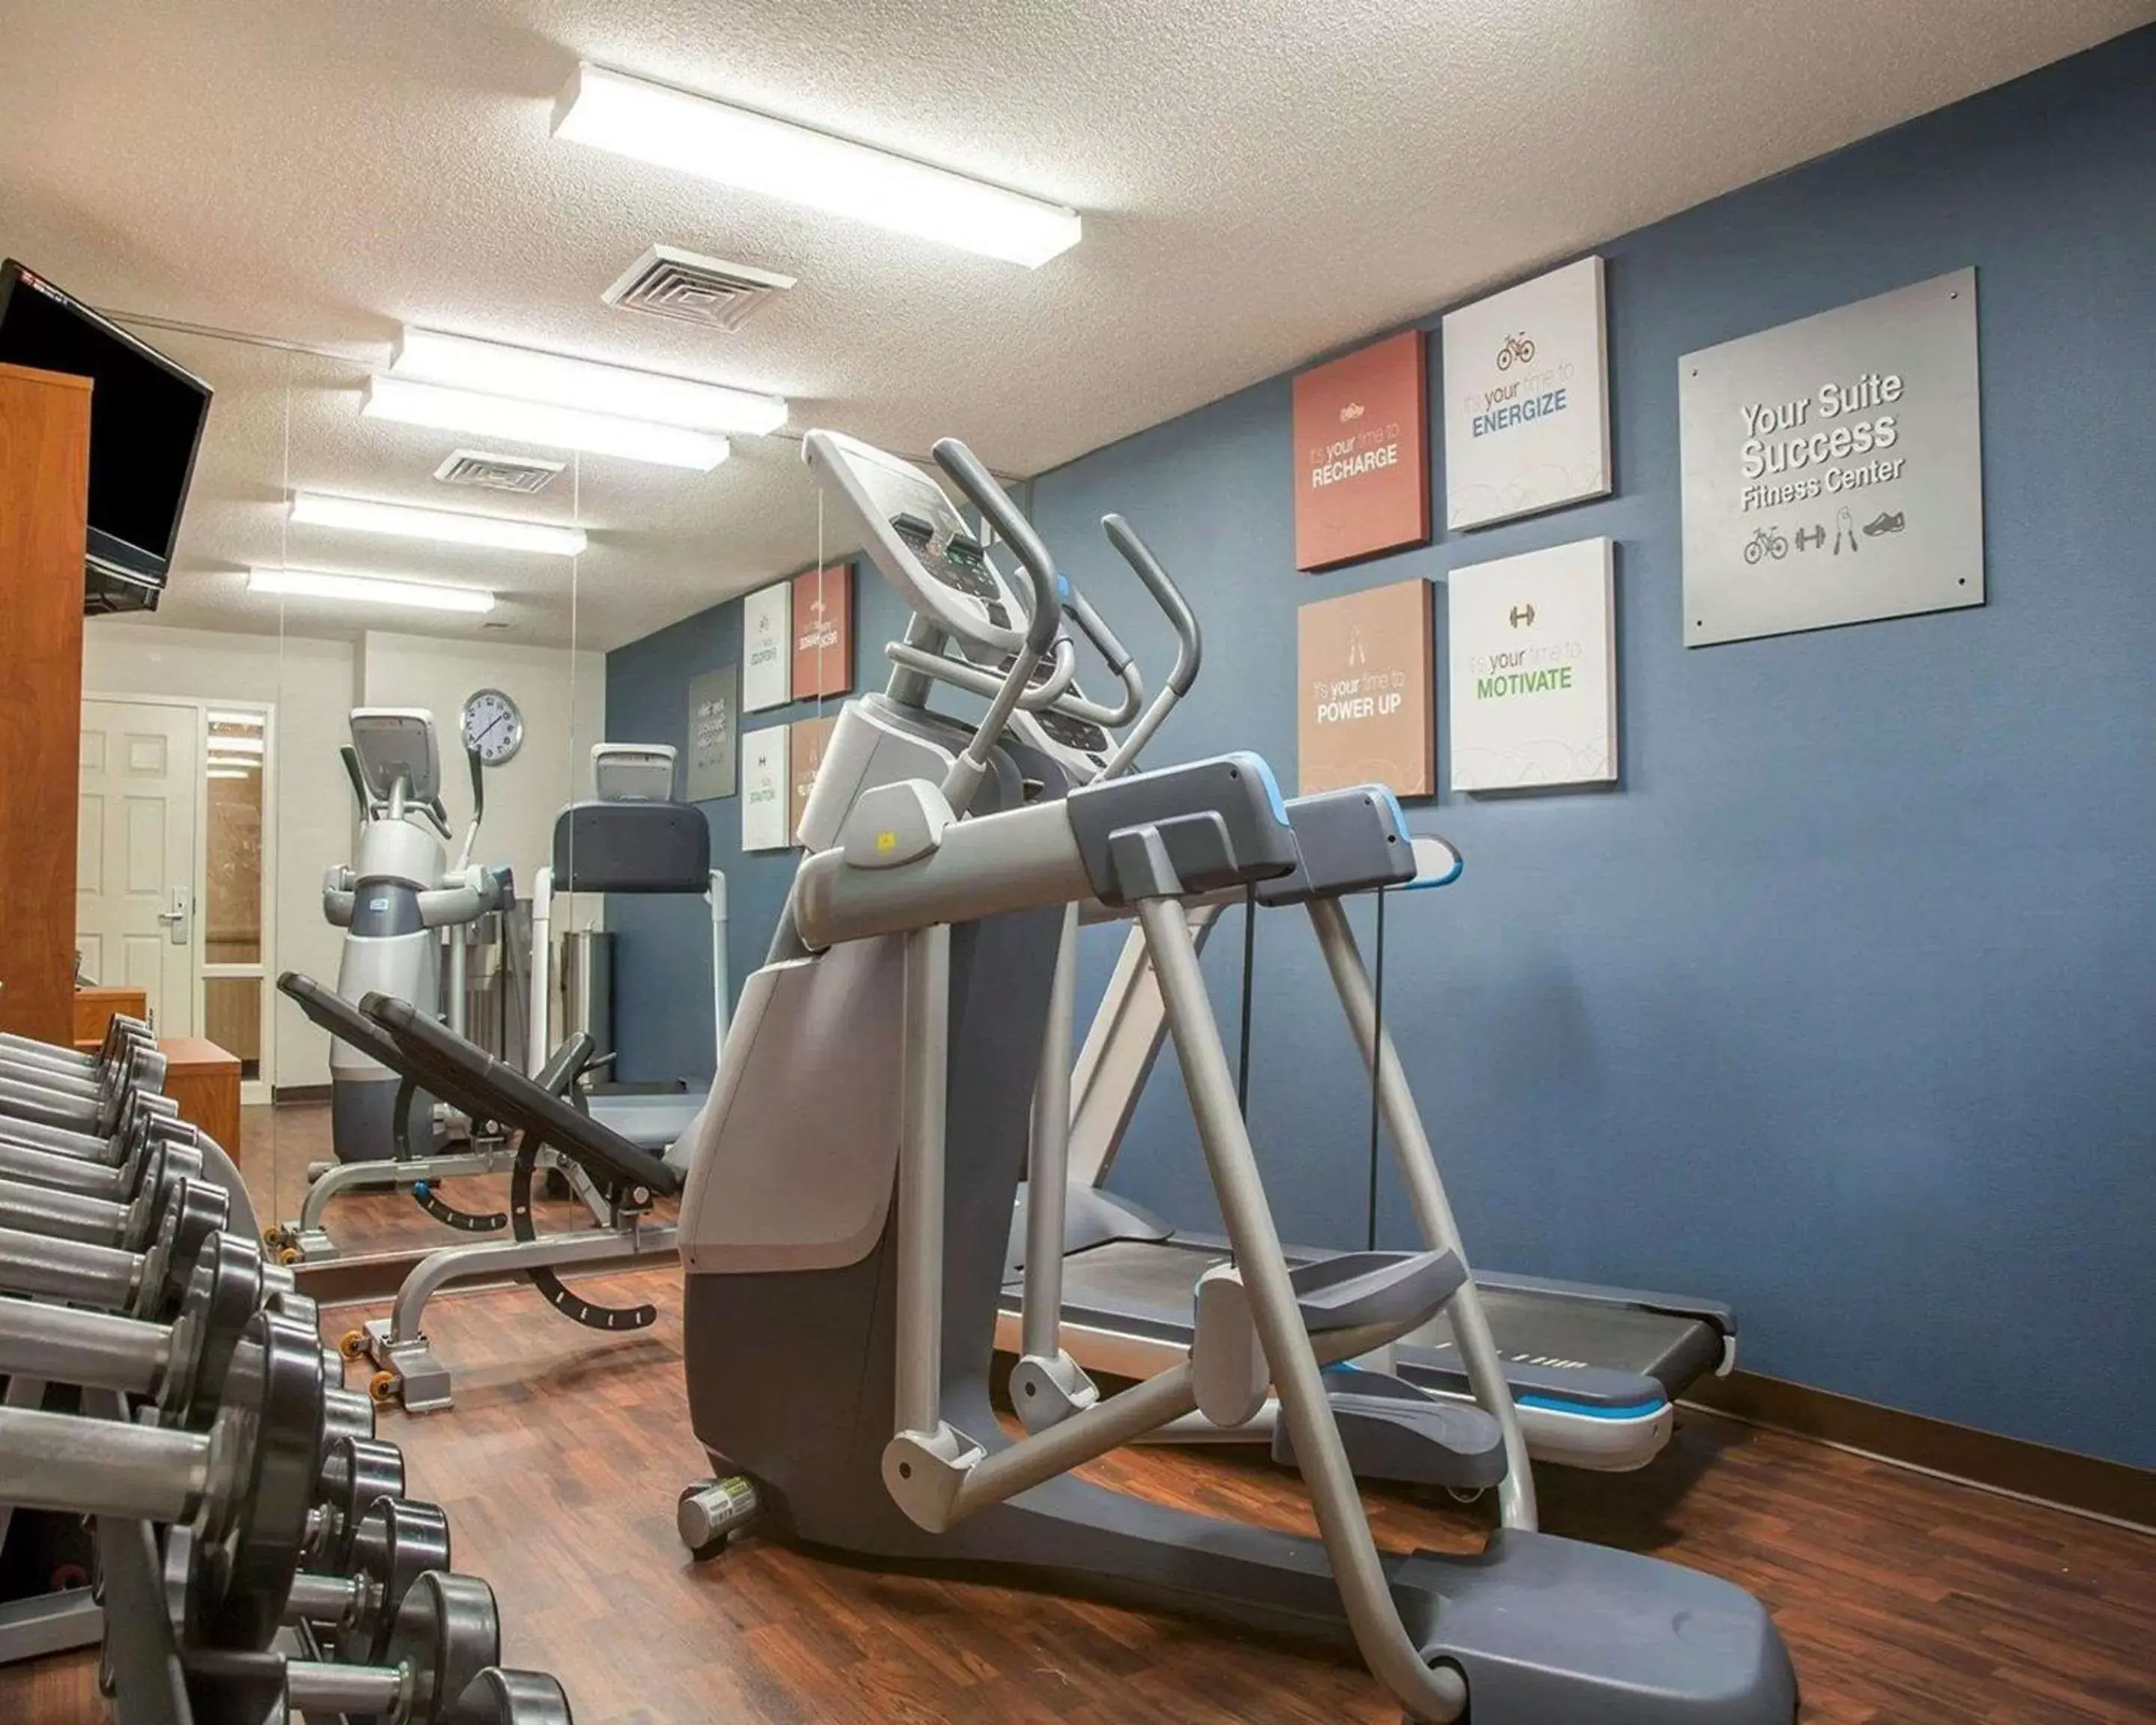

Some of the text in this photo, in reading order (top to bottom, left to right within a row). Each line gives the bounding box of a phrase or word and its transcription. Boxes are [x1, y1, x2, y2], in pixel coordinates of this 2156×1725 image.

[1472, 387, 1567, 439] ENERGIZE
[1484, 381, 1520, 412] your
[1741, 373, 1904, 438] Your Suite
[1327, 436, 1356, 465] your
[1741, 416, 1897, 479] Success
[1312, 443, 1398, 489] RECHARGE
[1741, 458, 1905, 511] Fitness Center
[1490, 650, 1526, 675] your
[1330, 678, 1359, 702] your
[1478, 666, 1572, 700] MOTIVATE
[1317, 693, 1402, 724] POWER UP
